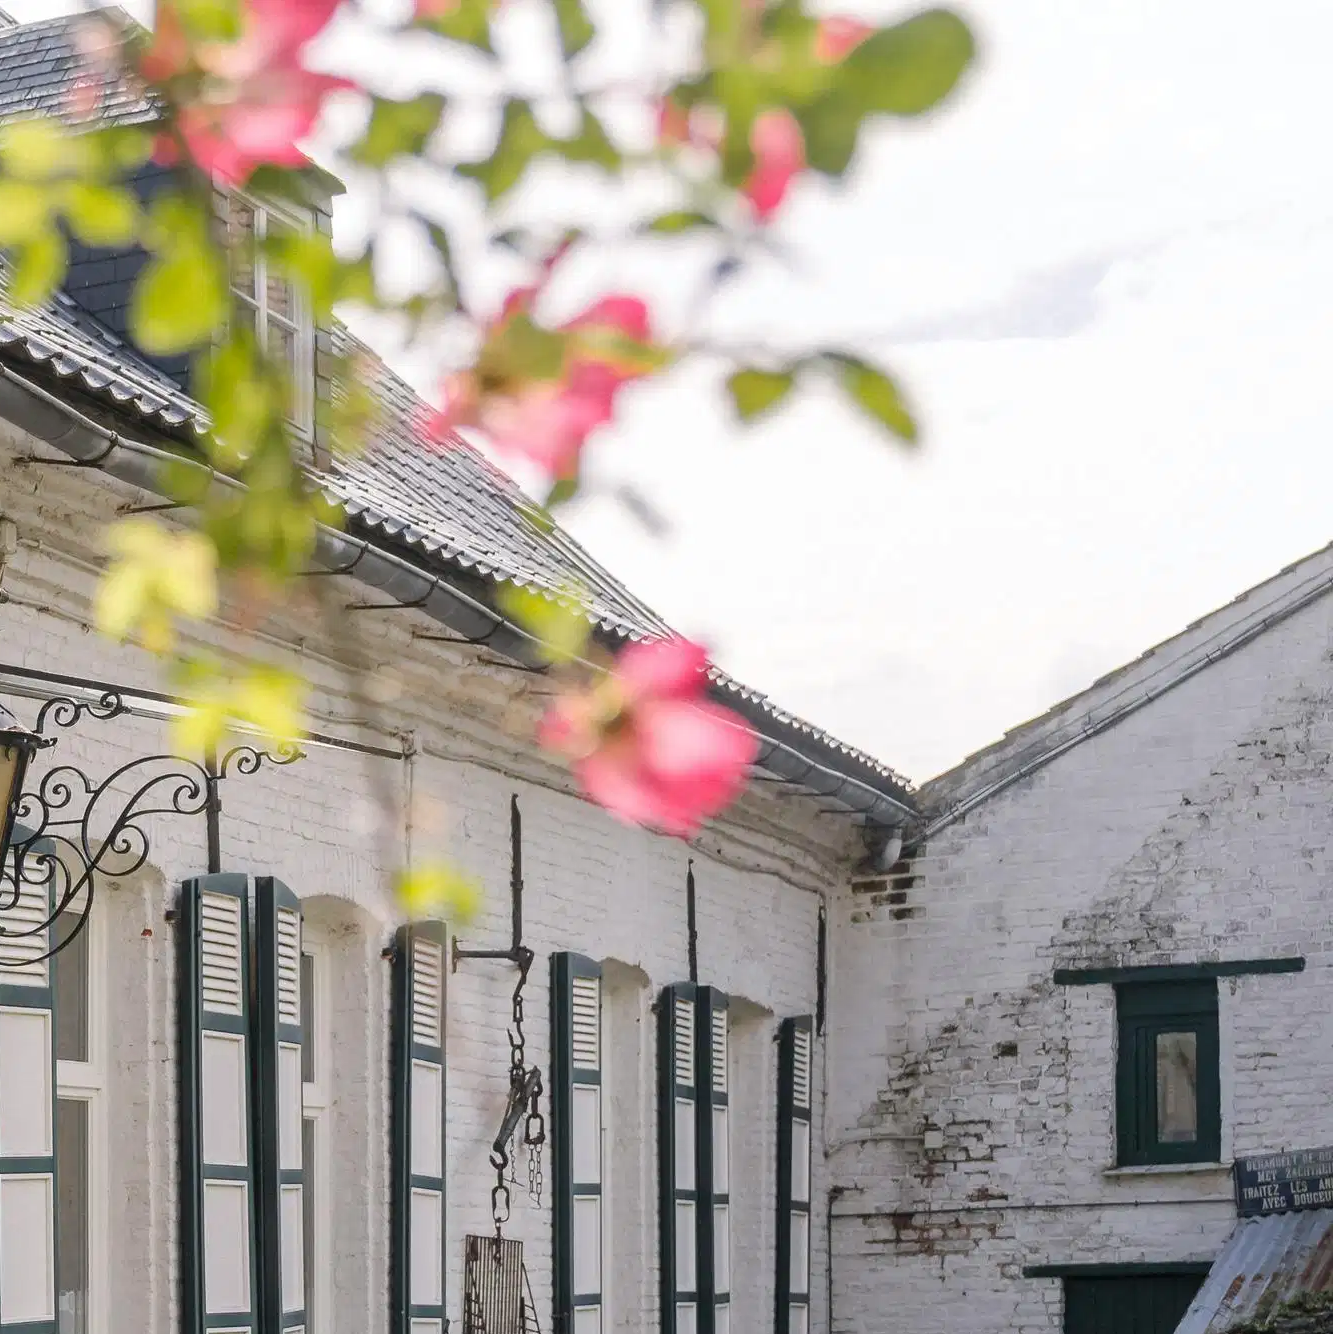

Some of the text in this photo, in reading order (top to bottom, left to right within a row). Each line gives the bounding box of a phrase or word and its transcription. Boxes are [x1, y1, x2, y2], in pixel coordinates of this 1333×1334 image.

[1257, 1162, 1333, 1182] MET ZACHTHEI
[1242, 1183, 1280, 1200] TRAITEZ
[1290, 1180, 1308, 1193] LES
[1261, 1190, 1333, 1210] AVEC DOUCEU
